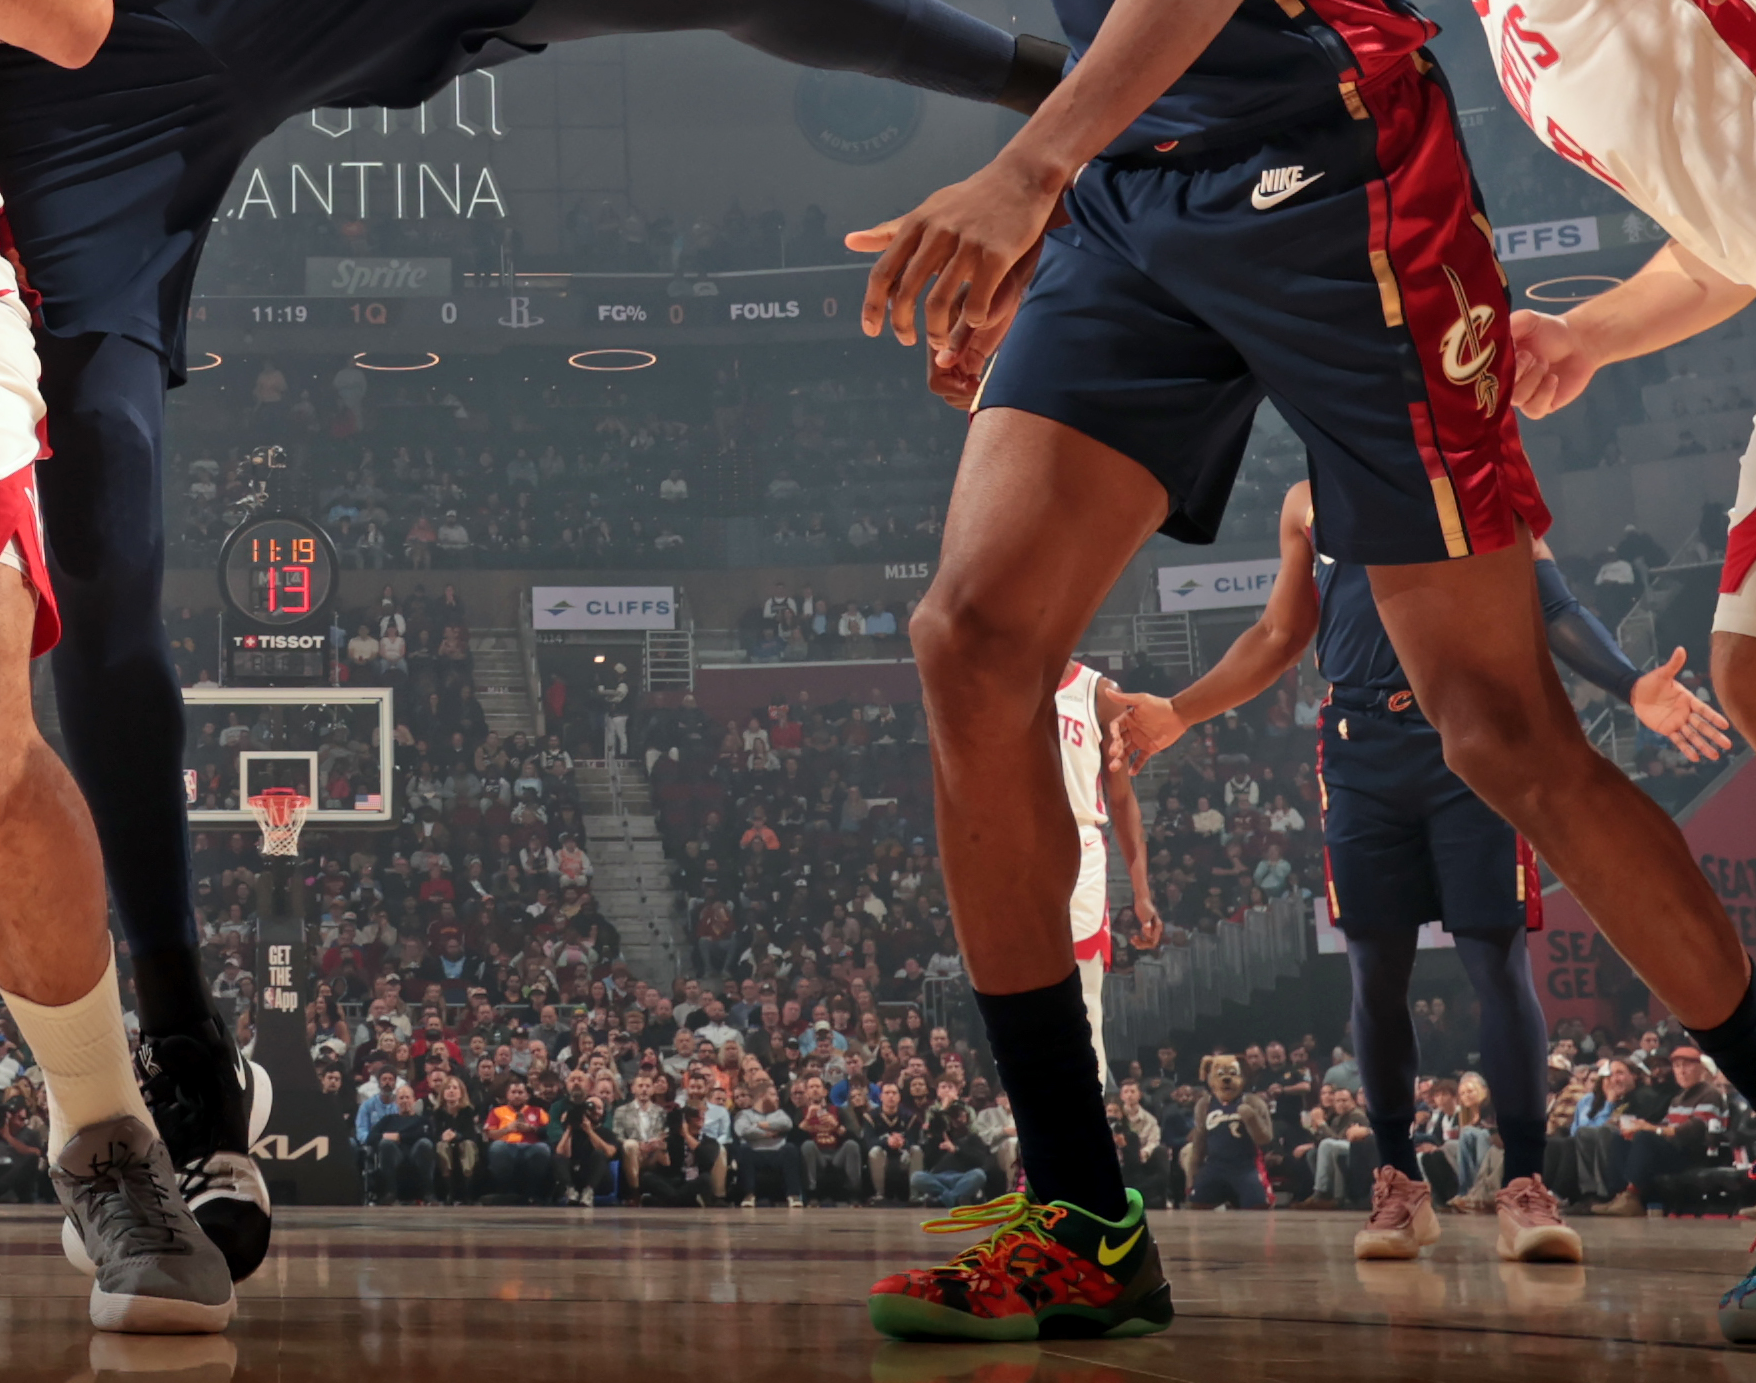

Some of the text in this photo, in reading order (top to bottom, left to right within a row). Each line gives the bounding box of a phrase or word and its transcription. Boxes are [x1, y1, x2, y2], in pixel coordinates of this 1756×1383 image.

[212, 162, 507, 220] ANTINA
[1260, 166, 1304, 194] NIKE
[1493, 225, 1582, 256] IFFS
[331, 259, 428, 294] Sprite
[252, 298, 838, 325] 11:19 1Q 0 FG% 0 FOULS 0
[252, 538, 317, 563] 11:19
[884, 563, 929, 579] M115
[267, 565, 312, 614] 13
[1214, 574, 1279, 594] CLIF
[586, 600, 671, 616] CLIFFS
[258, 634, 326, 649] TISSOT
[268, 945, 292, 966] GET
[268, 965, 293, 987] THE
[275, 987, 299, 1013] App
